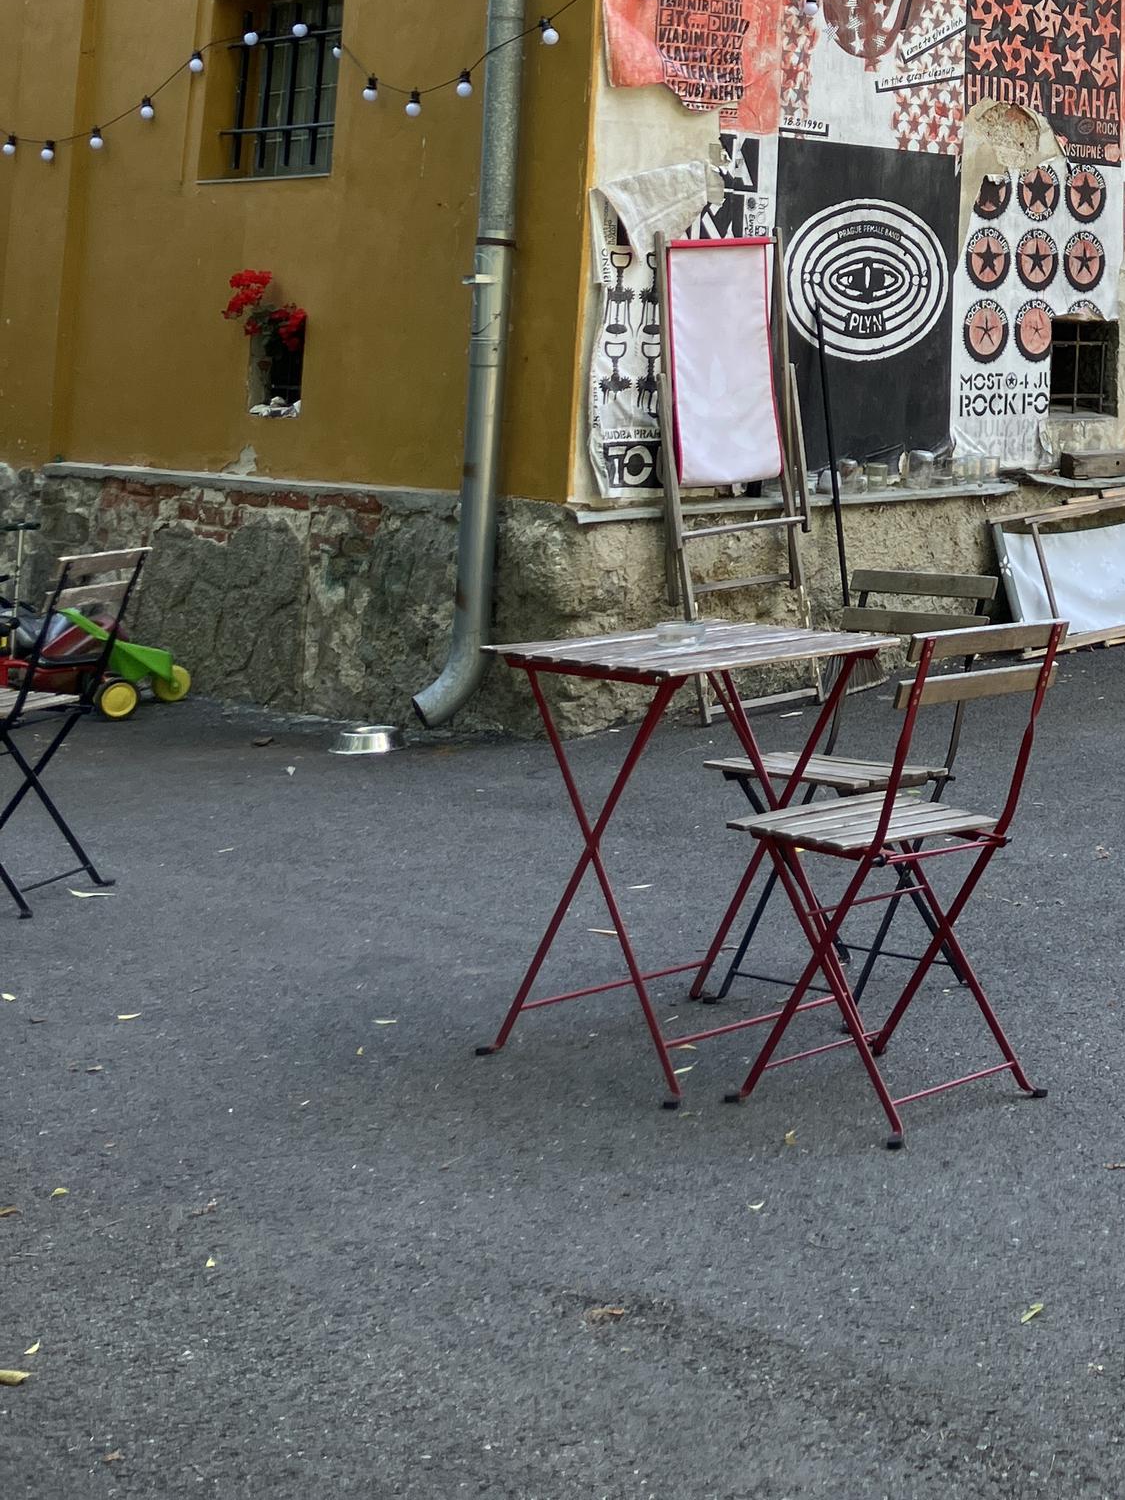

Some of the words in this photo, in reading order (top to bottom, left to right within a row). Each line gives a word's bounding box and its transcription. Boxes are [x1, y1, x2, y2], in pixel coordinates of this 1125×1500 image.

[967, 73, 1044, 113] HUDBA
[1050, 83, 1120, 121] PRAHA
[1096, 121, 1119, 136] ROCK
[838, 224, 863, 239] PRAGUE
[863, 224, 884, 236] FEMALE
[884, 226, 901, 242] BAND
[968, 231, 985, 254] ROCK
[984, 228, 999, 240] FOR
[997, 235, 1010, 254] LIFE
[1018, 232, 1034, 255] ROCK
[1032, 230, 1047, 241] FOR
[1046, 236, 1058, 255] LIFE
[1065, 234, 1080, 256] ROCK
[1080, 232, 1094, 243] FOR
[1093, 239, 1104, 257] LIFE
[848, 312, 884, 334] PLYN
[966, 301, 983, 326] ROCK
[981, 300, 996, 312] FOR
[995, 306, 1008, 326] LIFE
[1016, 301, 1032, 325] ROCK
[1031, 300, 1047, 312] FOR
[959, 372, 1004, 391] MOST
[1034, 371, 1050, 390] JU
[959, 392, 1018, 417] ROCK
[1021, 391, 1050, 415] FO
[634, 429, 661, 440] PRAH
